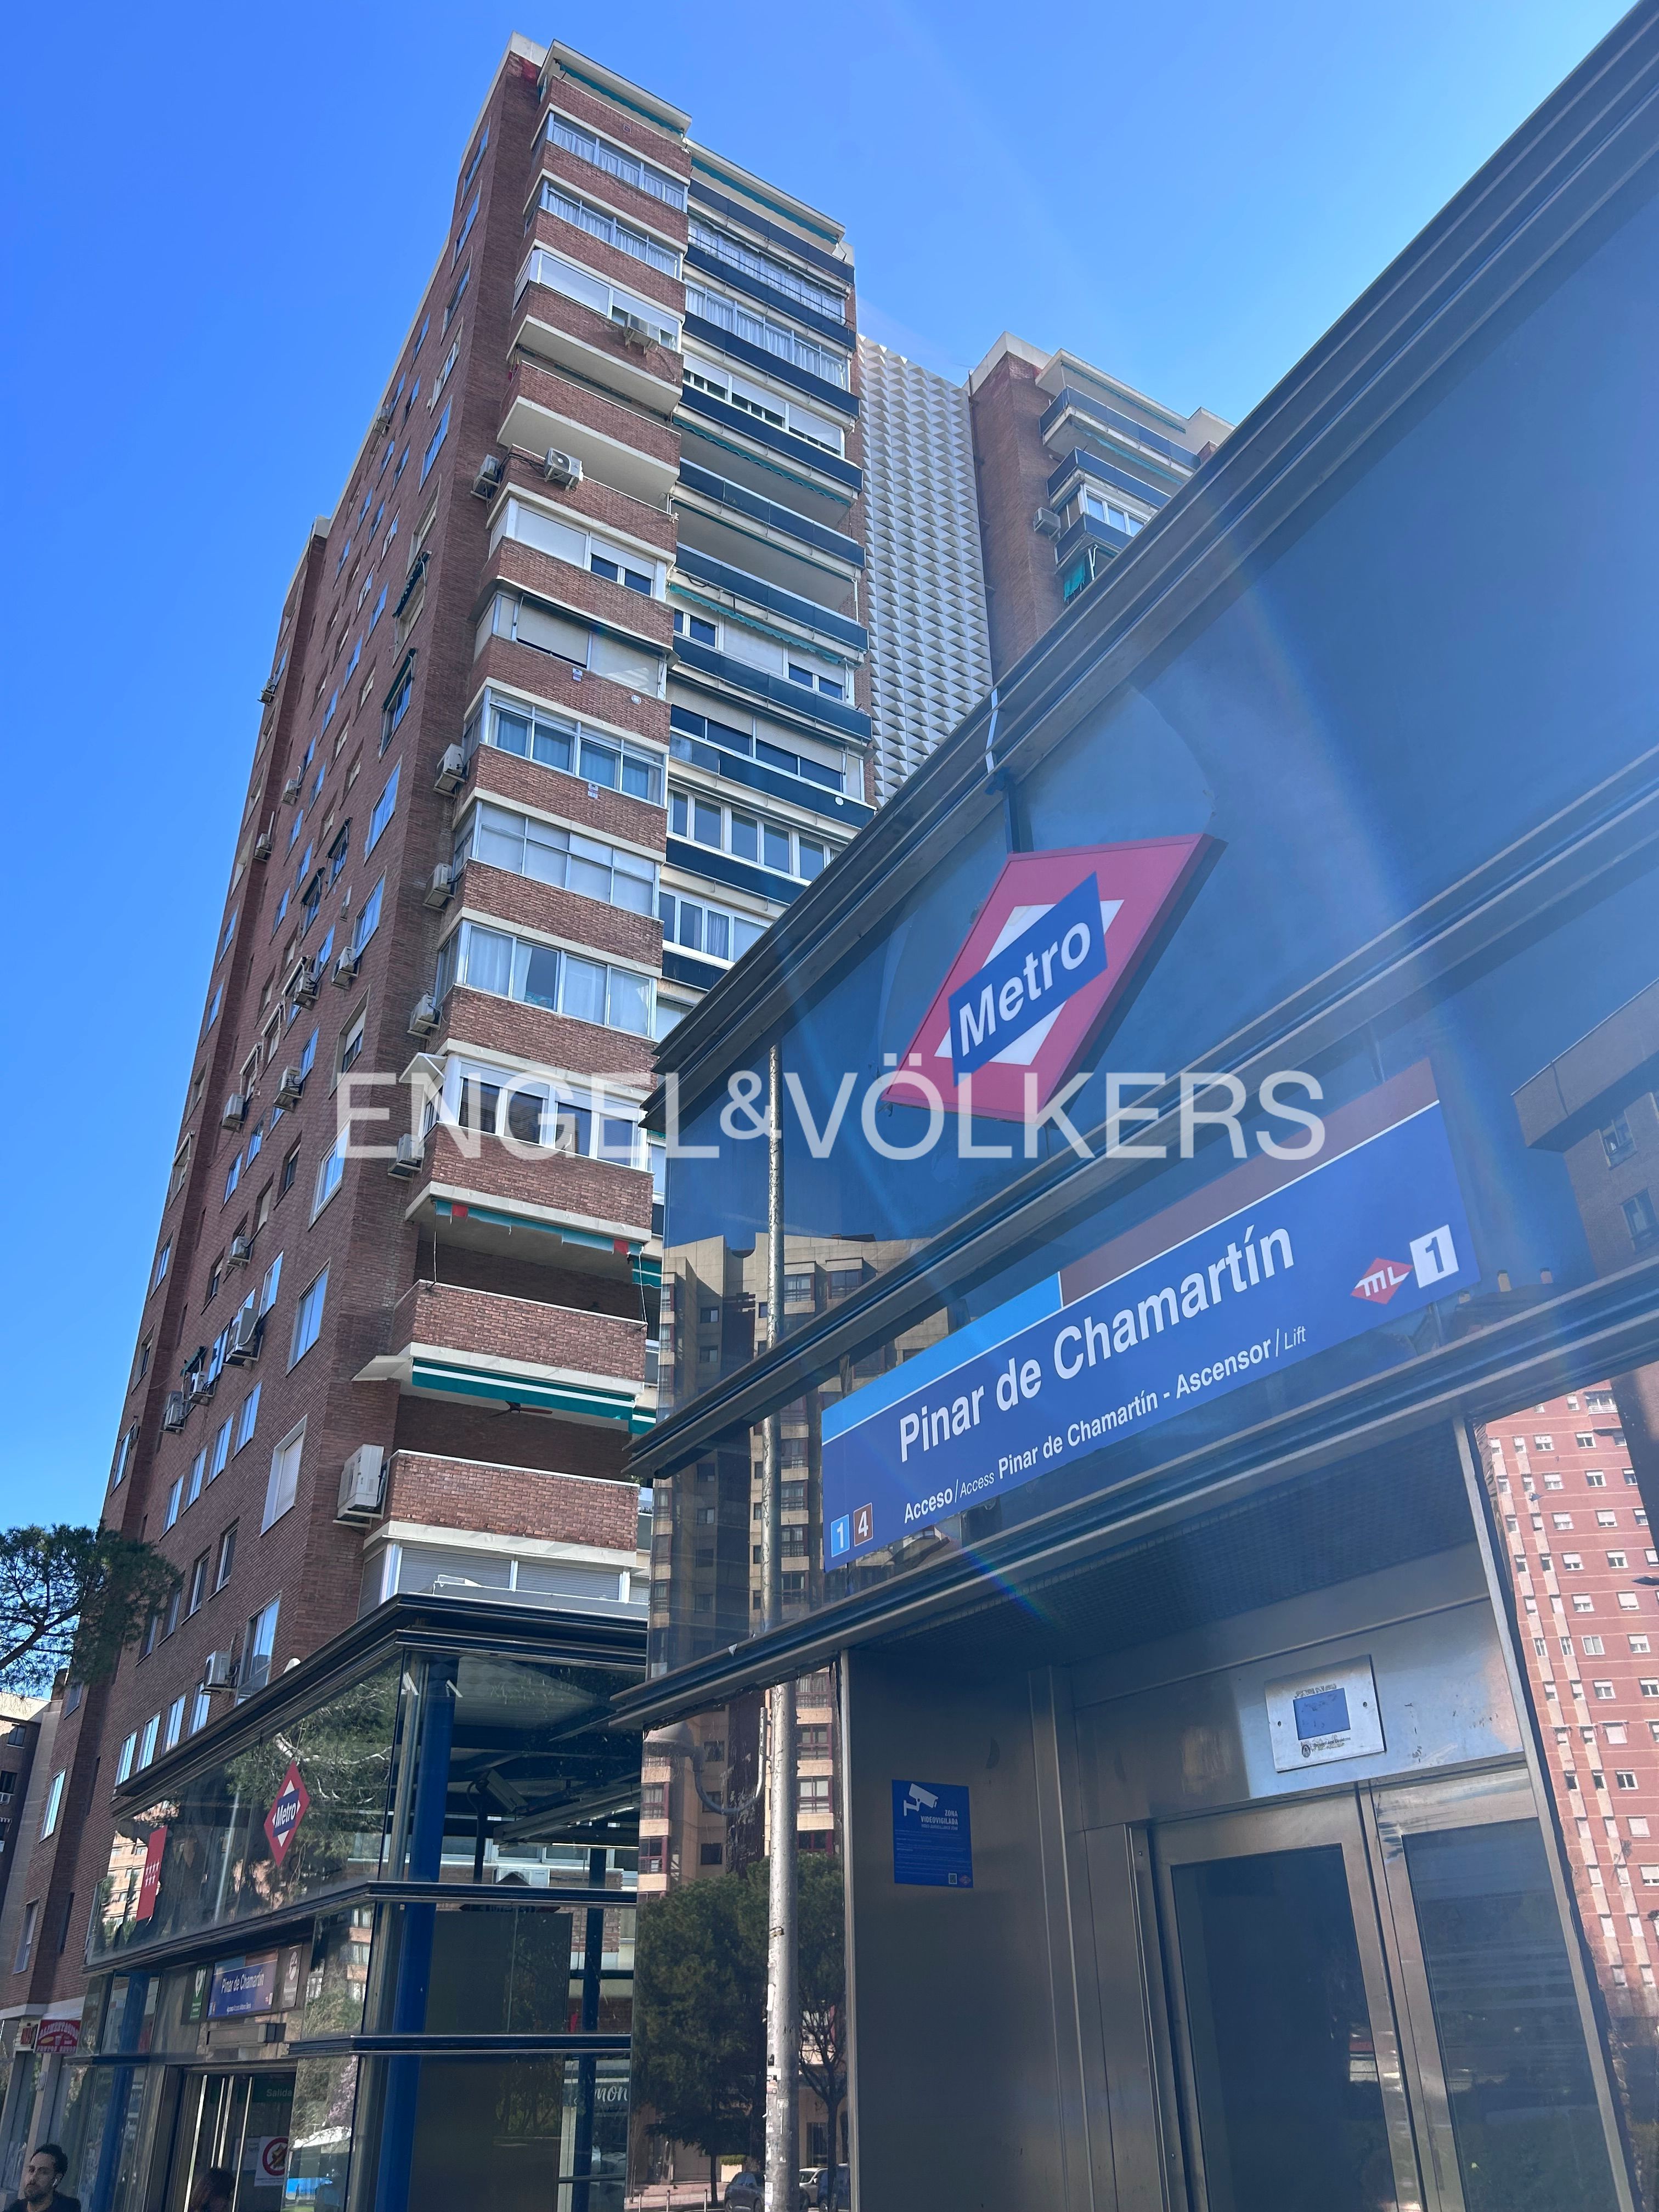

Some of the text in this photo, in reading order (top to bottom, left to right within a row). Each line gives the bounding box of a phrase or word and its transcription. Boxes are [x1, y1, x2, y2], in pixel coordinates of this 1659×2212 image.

[959, 922, 1091, 1057] Metro
[1425, 1236, 1444, 1273] 1
[900, 1224, 1295, 1463] Pinar de Chamartín
[998, 1444, 1038, 1479] Pinar
[1042, 1435, 1063, 1459] de
[1067, 1390, 1158, 1446] Chamartín
[837, 1522, 844, 1548] 1
[858, 1510, 868, 1537] 4
[274, 1802, 296, 1829] Metro
[921, 1815, 958, 1825] VIDEOVIGILADA
[221, 1978, 233, 1994] Pinar
[233, 1976, 240, 1991] de
[266, 2089, 292, 2097] Salida
